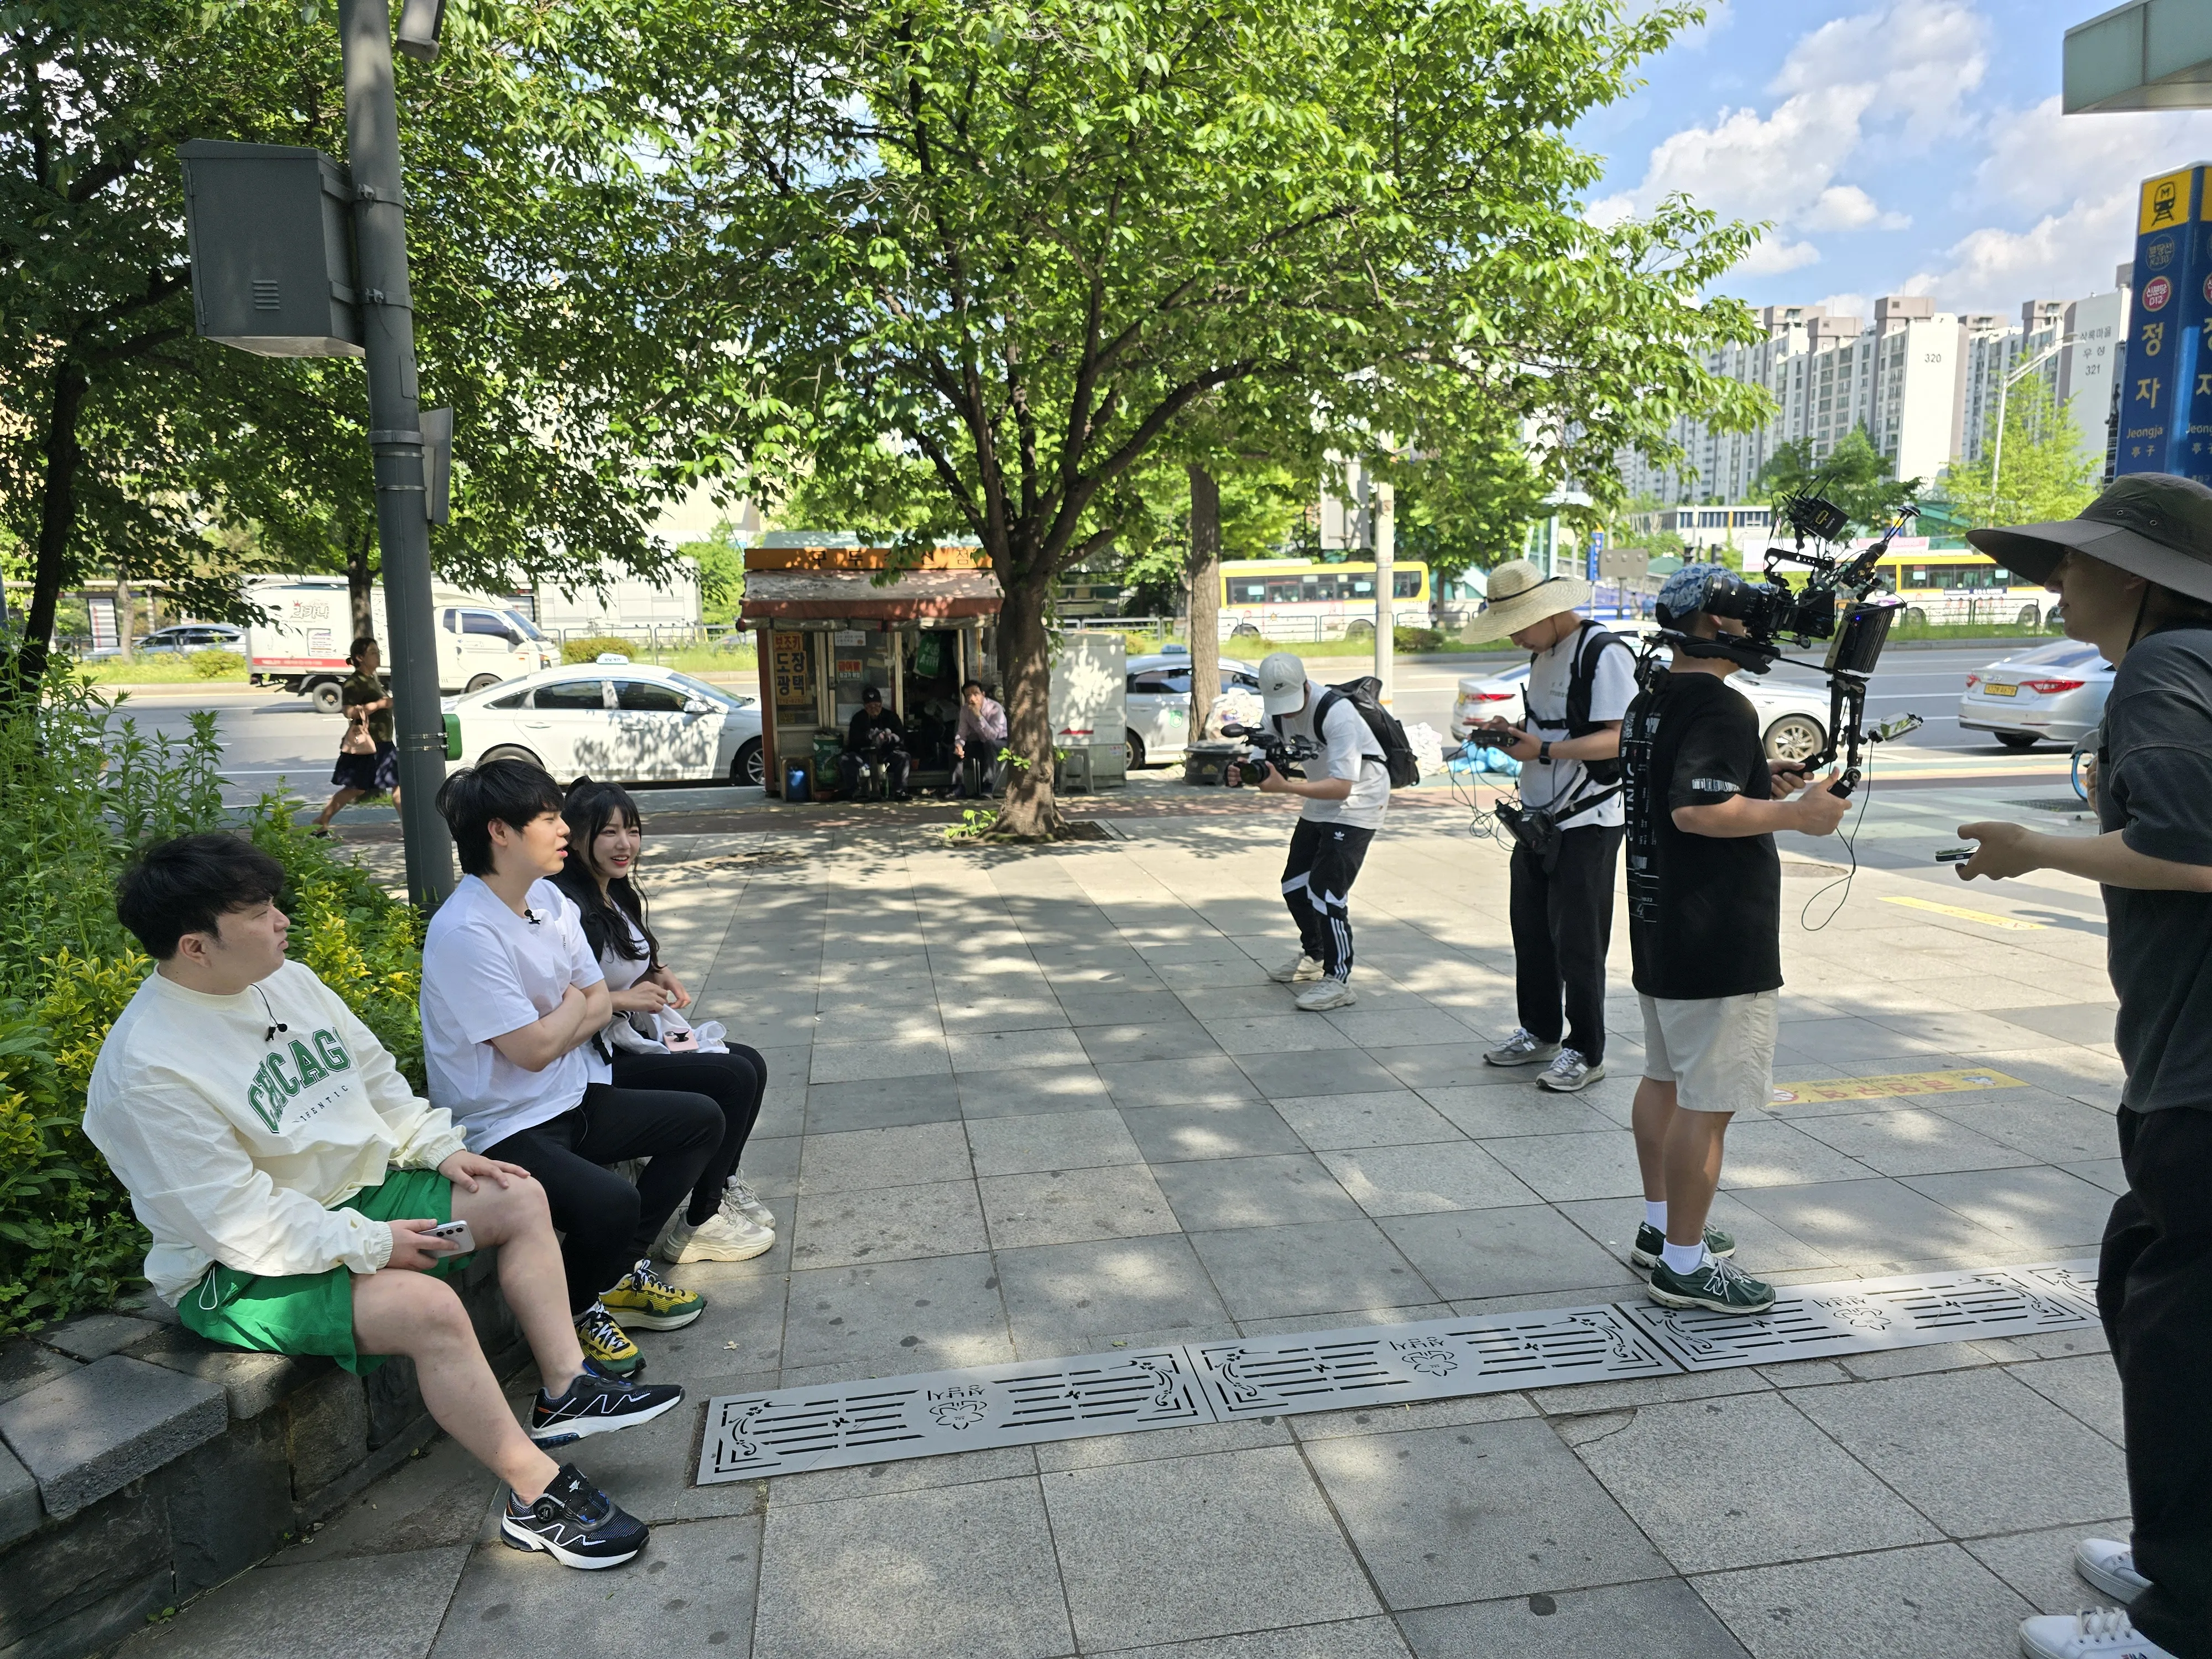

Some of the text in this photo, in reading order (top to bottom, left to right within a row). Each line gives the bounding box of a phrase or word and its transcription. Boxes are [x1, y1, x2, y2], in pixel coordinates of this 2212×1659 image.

[2146, 283, 2167, 298] 신분당
[1924, 353, 1942, 363] 320
[2135, 321, 2163, 410] 정자
[2085, 364, 2100, 376] 321
[2126, 425, 2163, 440] Jeongja
[775, 635, 800, 650] 보조키
[777, 652, 805, 672] 도장
[777, 675, 805, 696] 광택
[247, 1026, 351, 1134] CHICAG
[291, 1084, 349, 1123] THENTIC
[1812, 1295, 1867, 1308] 성남시
[1389, 1336, 1444, 1350] 성남시
[927, 1385, 985, 1401] 성남시
